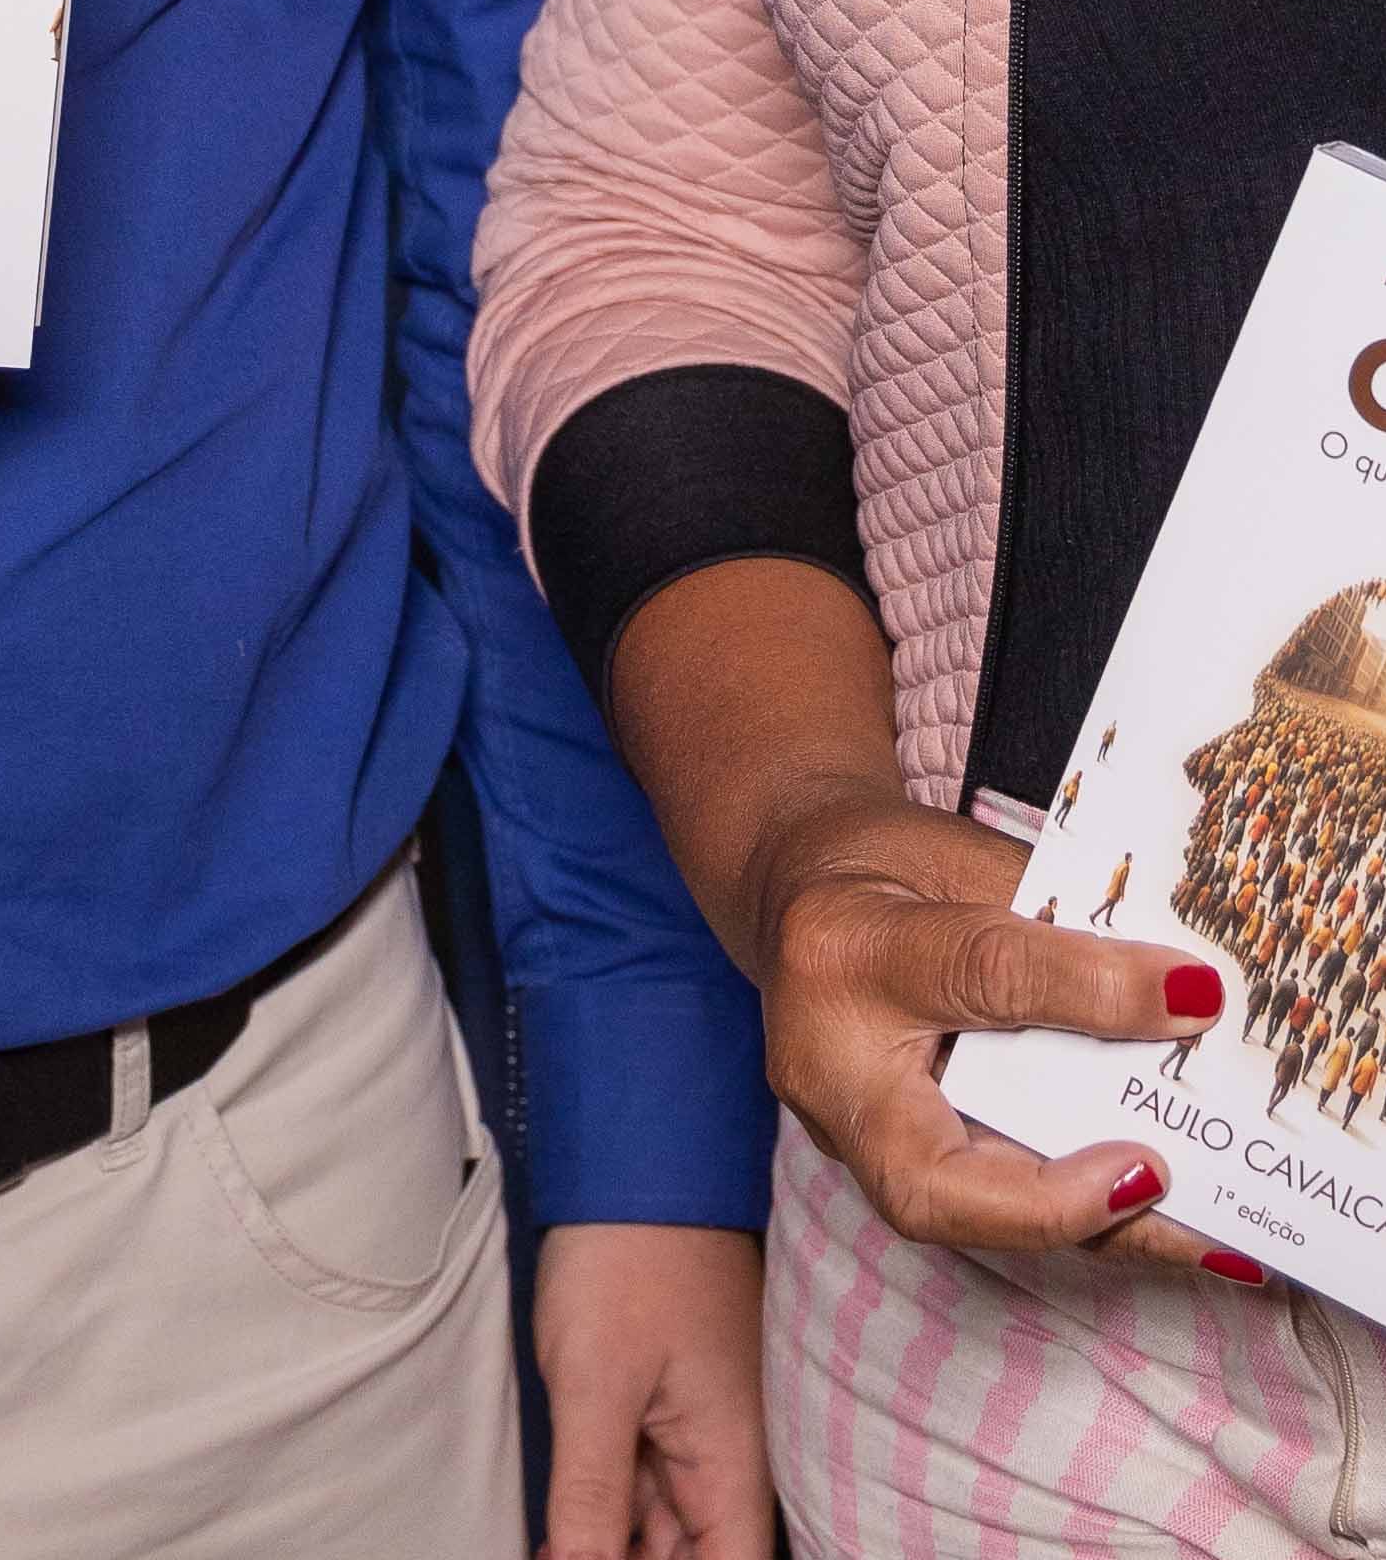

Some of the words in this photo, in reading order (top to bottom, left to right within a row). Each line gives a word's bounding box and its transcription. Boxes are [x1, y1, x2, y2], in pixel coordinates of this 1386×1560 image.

[1321, 431, 1348, 460] O
[1120, 1076, 1234, 1151] PAULO
[1237, 1205, 1305, 1247] edição
